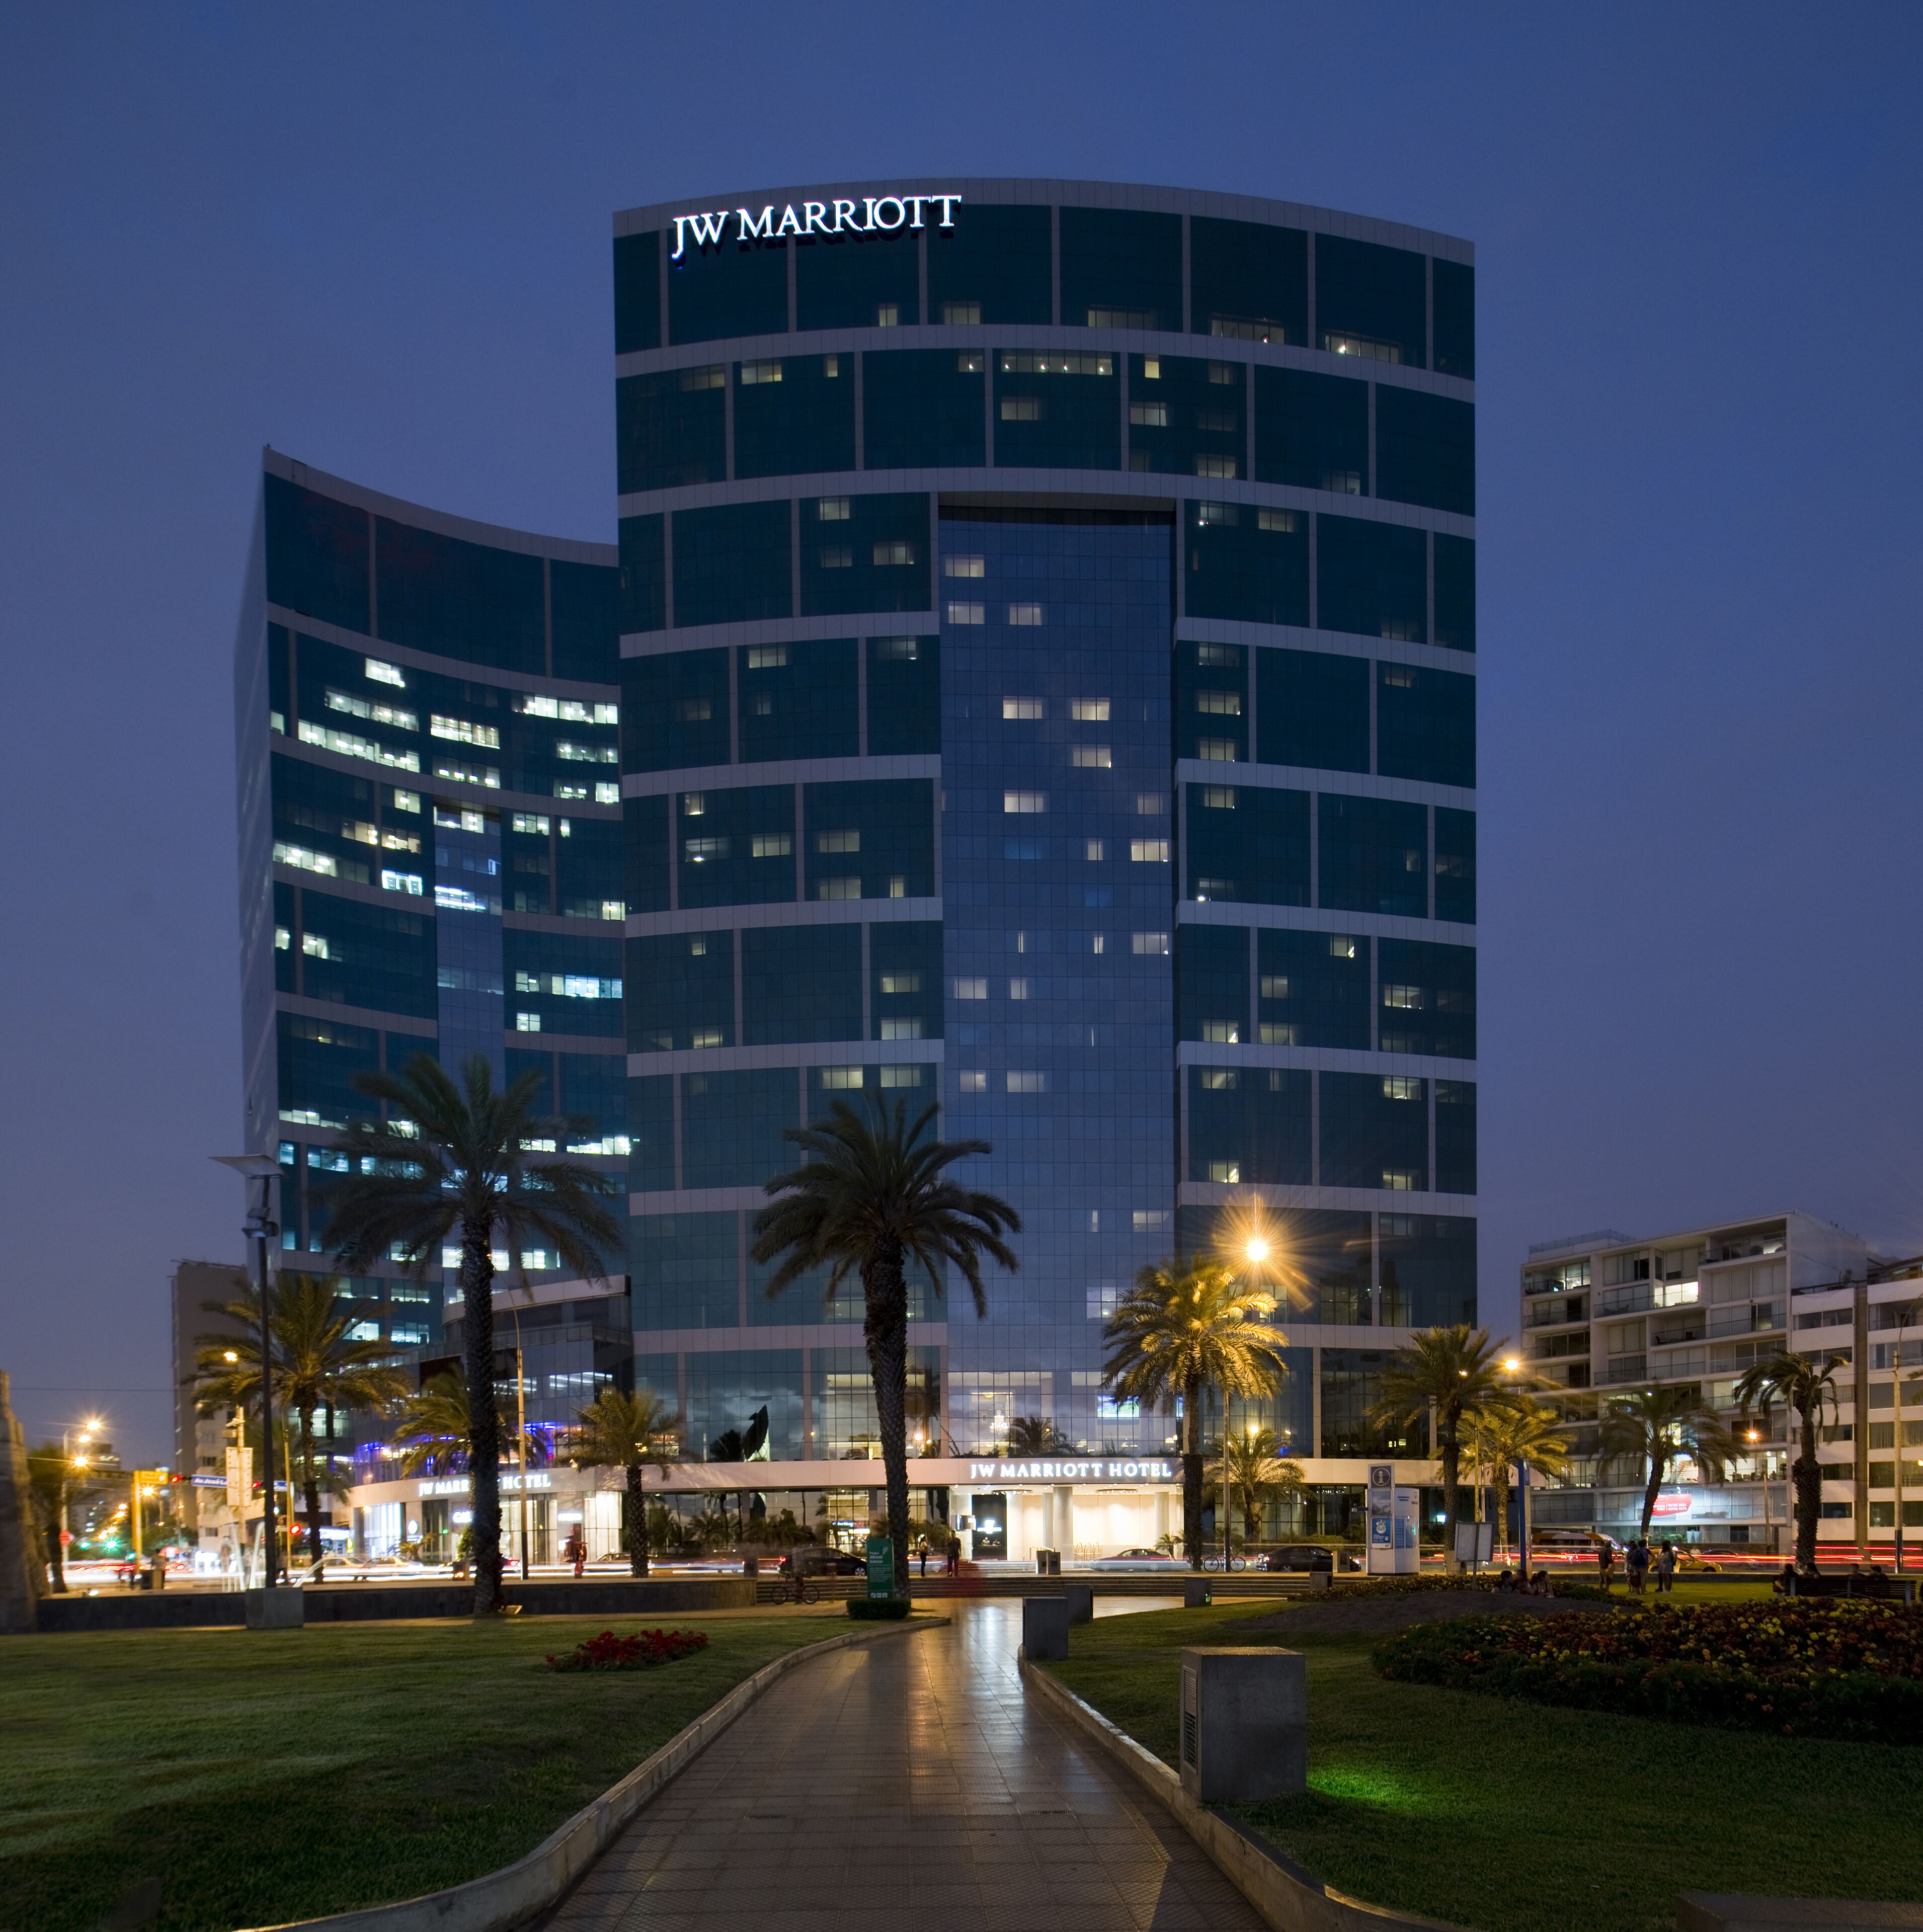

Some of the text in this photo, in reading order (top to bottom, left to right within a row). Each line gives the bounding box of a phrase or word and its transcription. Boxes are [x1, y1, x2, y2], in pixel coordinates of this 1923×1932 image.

[672, 195, 962, 258] JW MARRIOTT
[971, 1462, 1172, 1479] JW MARRIOTT HOTEL
[418, 1482, 434, 1497] JW
